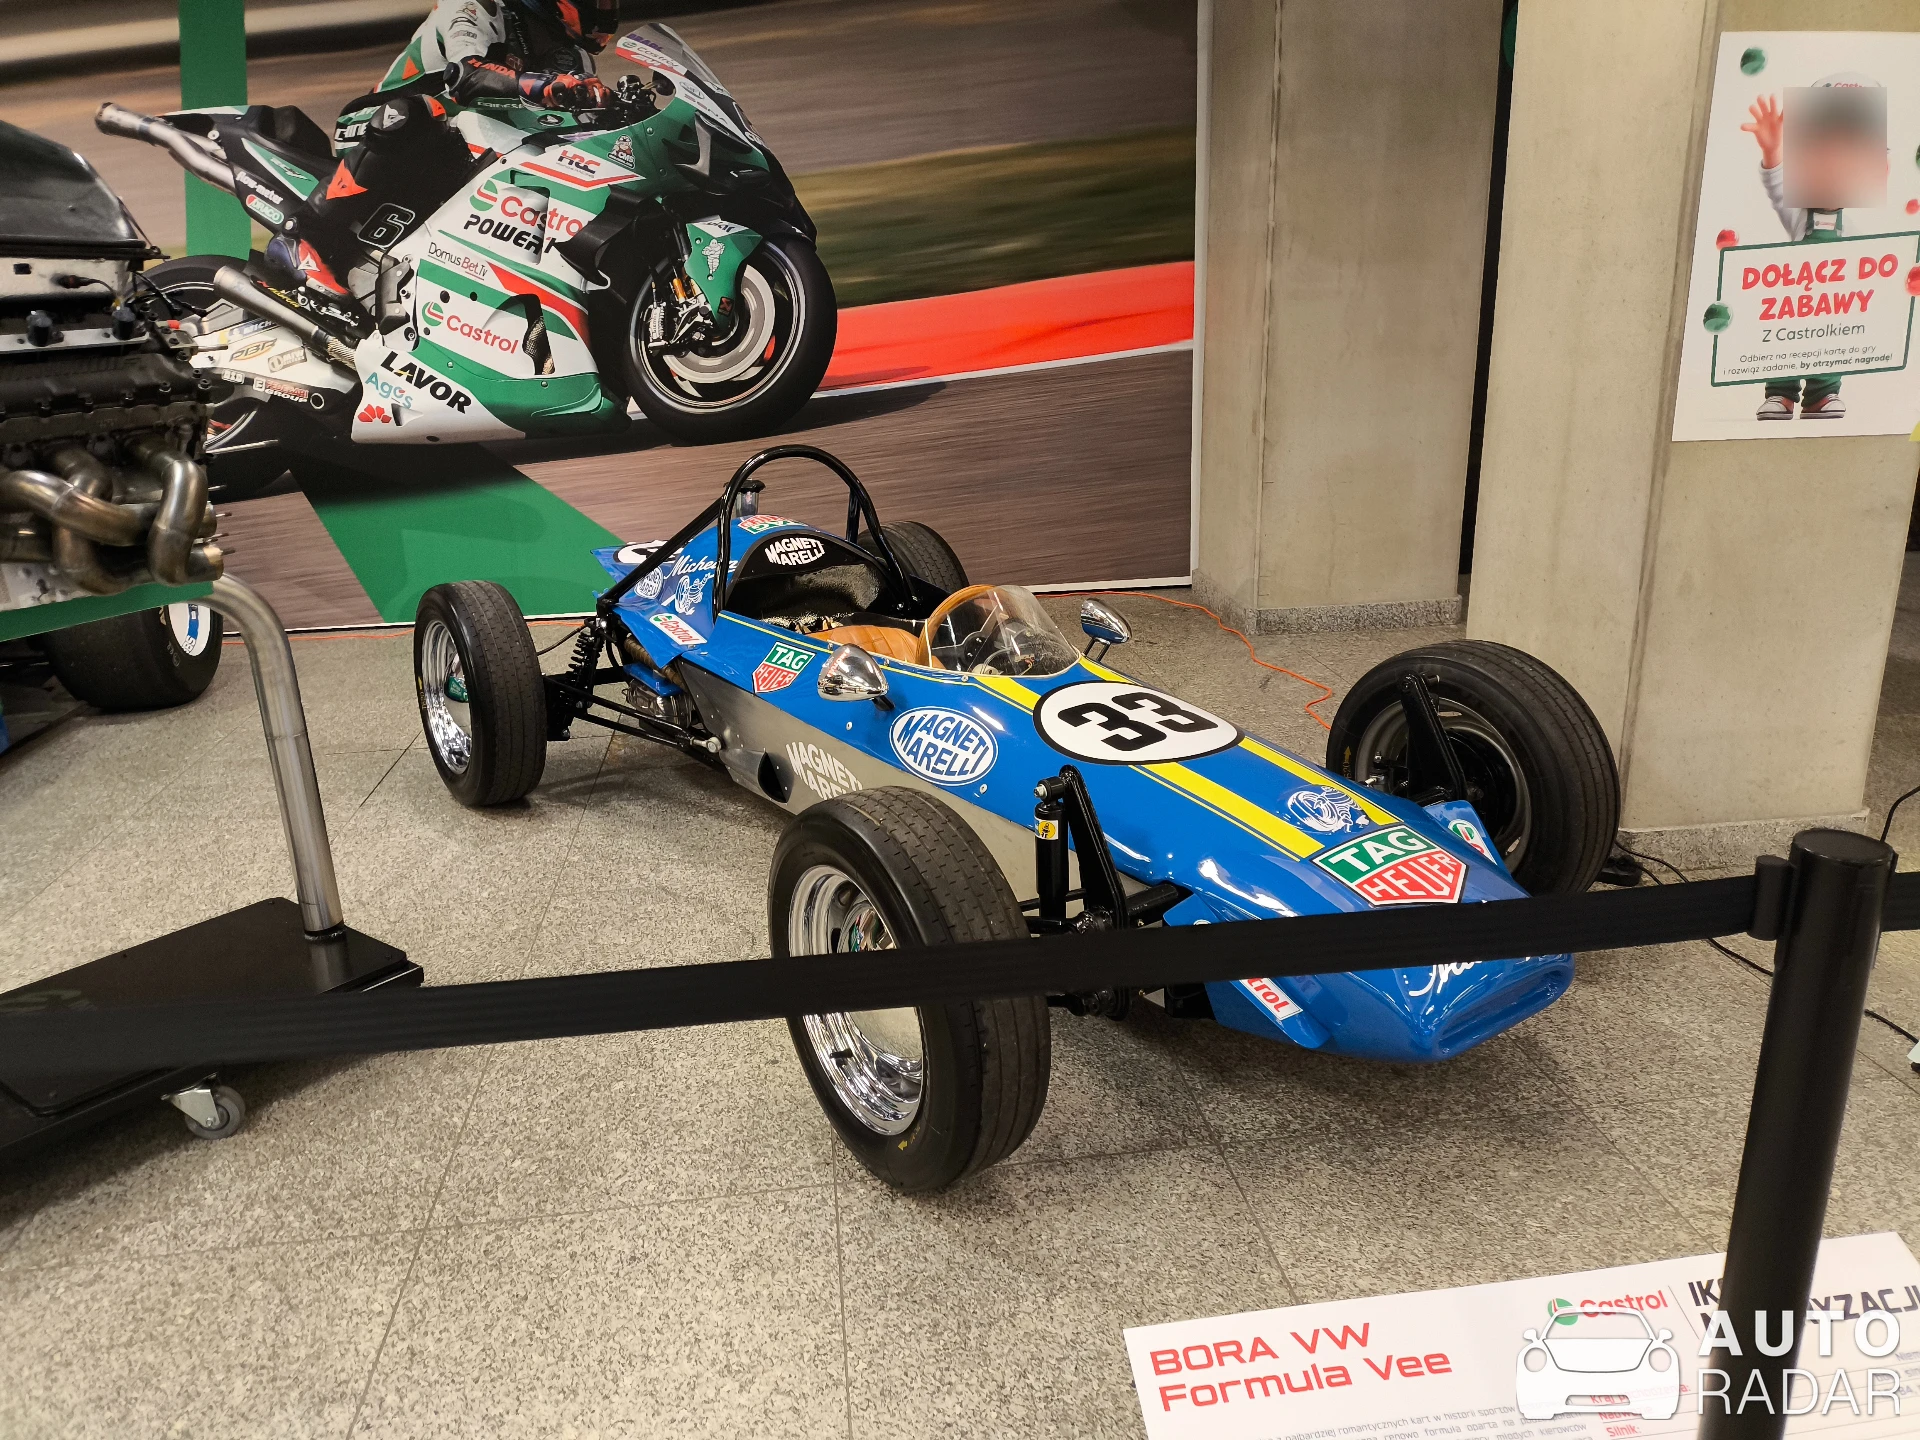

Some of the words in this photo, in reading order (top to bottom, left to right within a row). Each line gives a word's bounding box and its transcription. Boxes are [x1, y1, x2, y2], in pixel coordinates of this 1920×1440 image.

[467, 58, 516, 79] HNDA
[558, 150, 601, 174] HRC
[236, 171, 284, 204] flow-meter
[252, 201, 280, 221] DRACO
[357, 202, 415, 250] 6
[500, 195, 583, 237] Castro
[1742, 259, 1846, 291] DOŁĄCZ
[1858, 253, 1899, 279] DO
[1759, 289, 1875, 320] ZABAWY
[446, 314, 519, 354] Castrol
[1775, 322, 1865, 342] Castrolkiem
[229, 338, 278, 362] PBR
[1739, 354, 1773, 363] Odbierz
[1789, 349, 1822, 361] recepcji
[1824, 347, 1847, 356] kartę
[1848, 345, 1860, 354] do
[1862, 345, 1876, 355] gry
[1800, 361, 1811, 370] by
[1812, 357, 1852, 369] otrzymać
[1854, 354, 1893, 365] nagrodę!
[365, 372, 413, 409] Agos
[380, 350, 472, 414] LAVOR
[765, 537, 825, 558] MAGNETI
[664, 555, 739, 579] Michen
[660, 619, 699, 642] Castrol
[772, 647, 808, 669] TAG
[757, 665, 794, 690] HEUER
[897, 714, 989, 757] MAGNETI
[1057, 691, 1219, 751] 33
[897, 732, 989, 776] MARELLI
[1328, 832, 1428, 872] TAG
[1362, 853, 1457, 897] HEUER
[1247, 978, 1290, 1012] trol
[1580, 1290, 1668, 1318] Castrol
[1150, 1336, 1280, 1375] BORA
[1290, 1322, 1370, 1354] VW
[1159, 1363, 1352, 1412] Formula
[1363, 1352, 1452, 1381] Vee
[1338, 1418, 1409, 1435] romantycznych
[1410, 1414, 1431, 1425] kart
[1433, 1414, 1441, 1422] w
[1443, 1410, 1476, 1421] historii
[1478, 1405, 1515, 1419] sportów
[1466, 1420, 1498, 1433] oparta
[1503, 1418, 1515, 1427] na
[1538, 1422, 1587, 1436] kierowców
[1606, 1425, 1641, 1438] Silnik:
